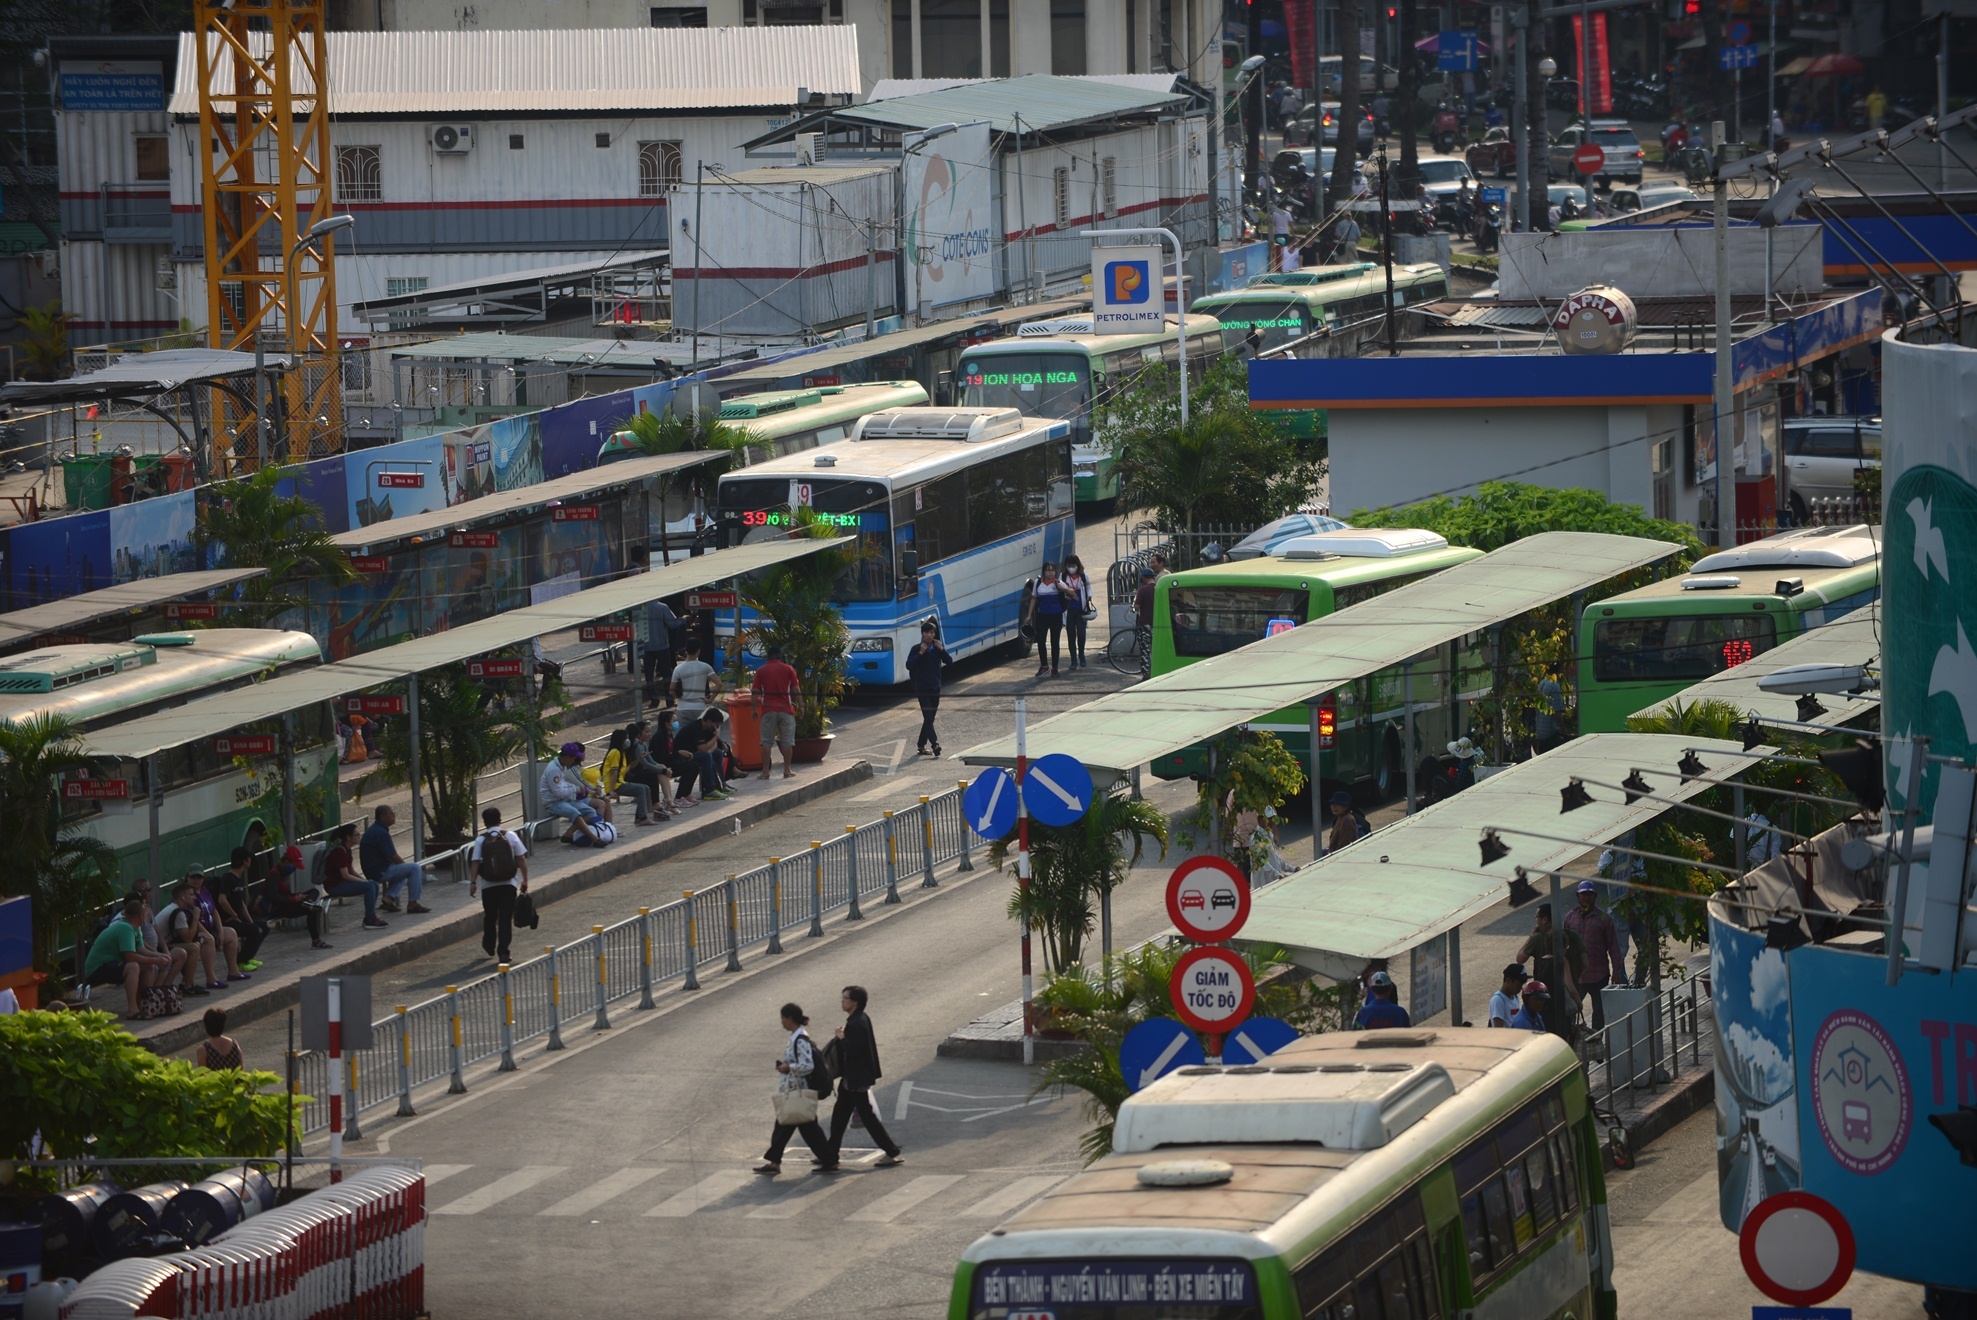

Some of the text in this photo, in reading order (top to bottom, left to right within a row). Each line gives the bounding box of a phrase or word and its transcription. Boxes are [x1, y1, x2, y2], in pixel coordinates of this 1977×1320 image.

[65, 76, 84, 86] HÃY
[86, 76, 110, 86] LUÔN
[113, 76, 137, 86] NGHĨ
[64, 88, 162, 98] AN TOÀN LÀ TRÊN HẾT
[1558, 294, 1617, 325] DAPHA
[1097, 312, 1160, 322] PETROLIMEX
[966, 374, 983, 386] 19
[474, 442, 490, 454] NIPPON
[476, 452, 488, 462] PAINT
[743, 511, 767, 526] 39
[1274, 623, 1292, 635] 0
[69, 786, 80, 795] 152
[1195, 966, 1229, 986] GIẢM
[1188, 988, 1236, 1012] TỐC ĐỘ
[1882, 1038, 1897, 1062] HÀNH
[1894, 1063, 1906, 1094] KHÁCH
[984, 1267, 1007, 1303] BẾN
[1007, 1269, 1044, 1303] THÀNH
[1050, 1265, 1096, 1302] NGUYỄN
[1097, 1268, 1120, 1302] VĂN
[1121, 1274, 1147, 1301] LINH
[1154, 1265, 1176, 1301] BẾN
[1178, 1274, 1193, 1301] XE
[1194, 1264, 1223, 1301] MIỀN
[1223, 1267, 1245, 1301] TÂY
